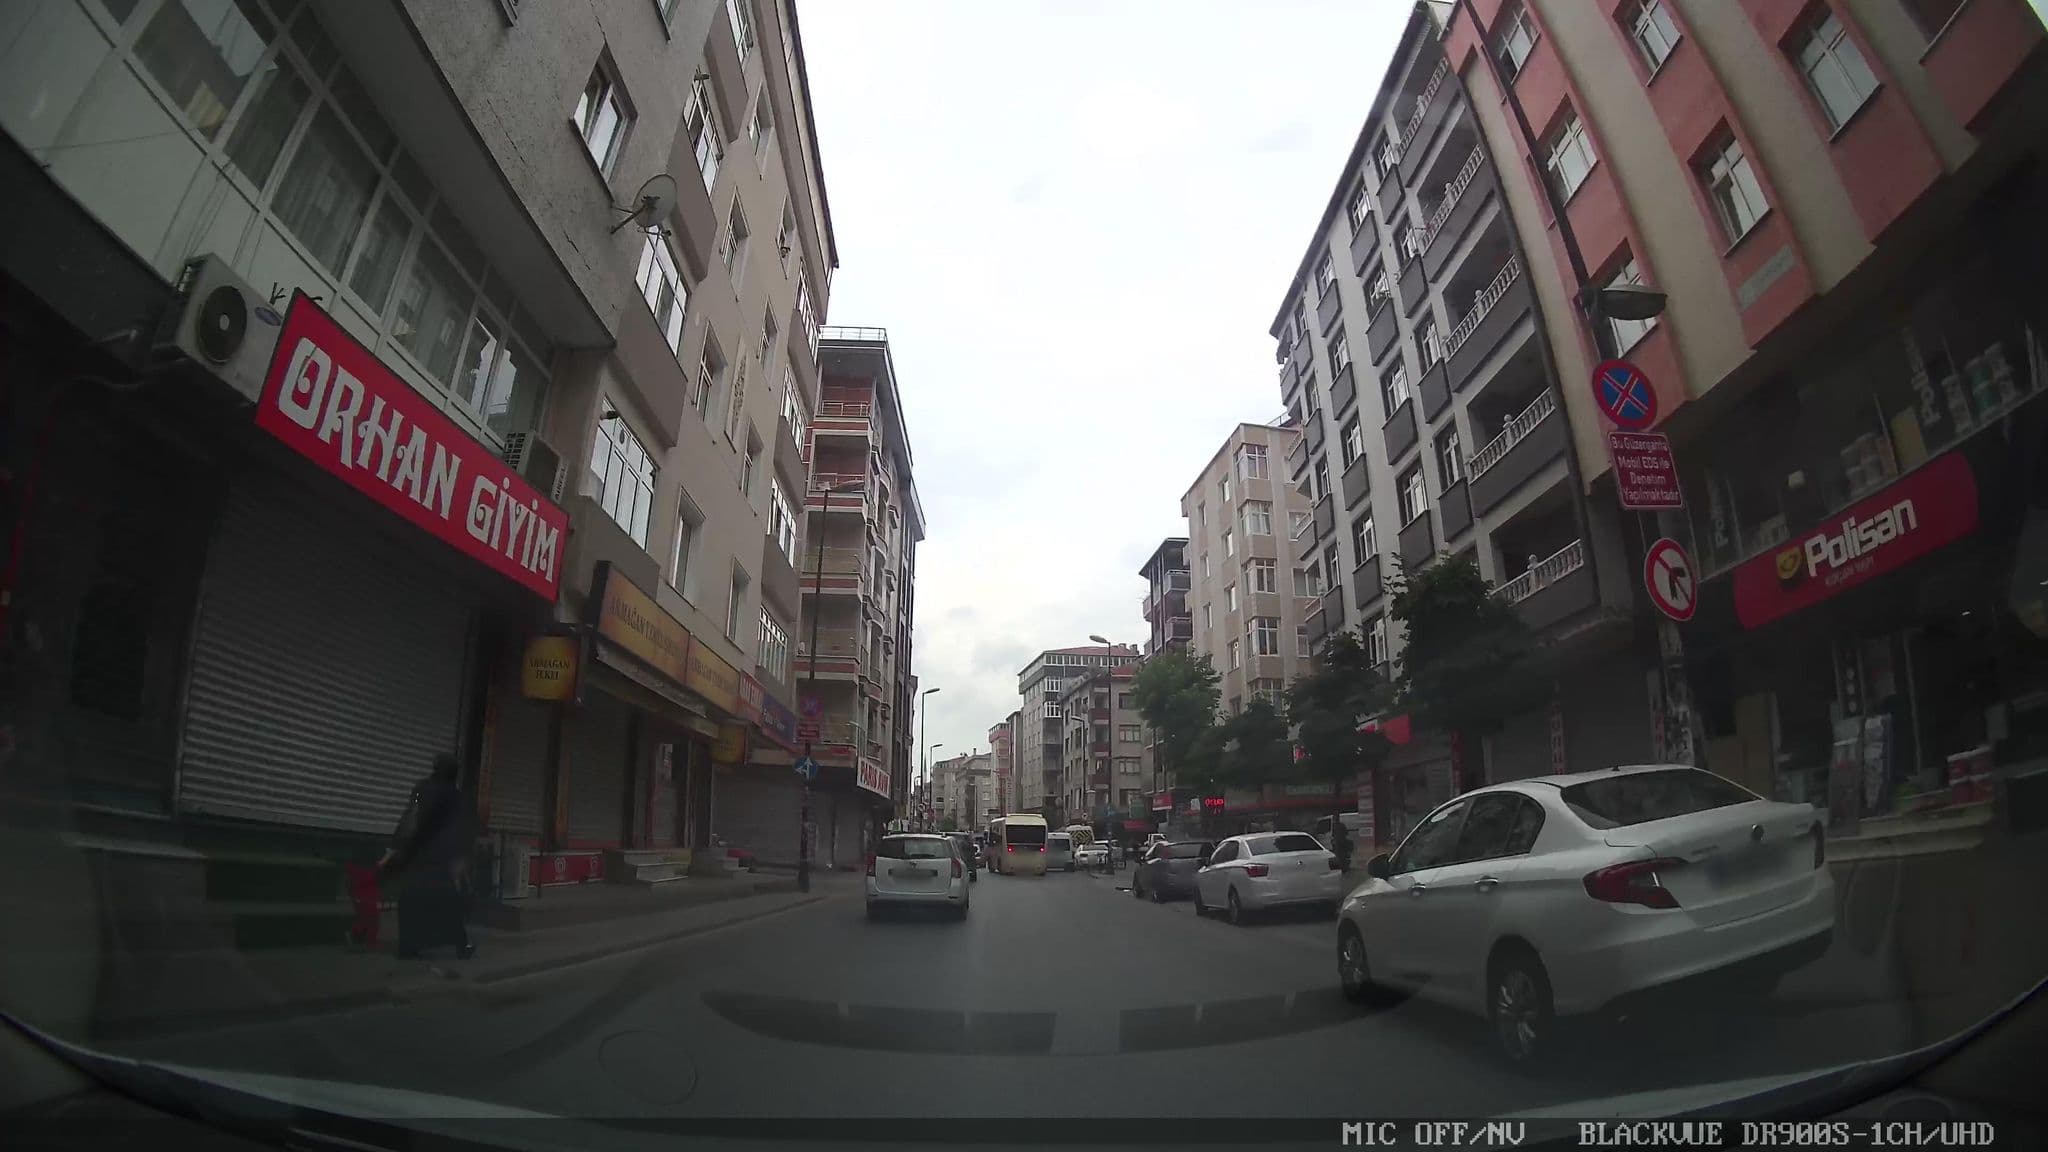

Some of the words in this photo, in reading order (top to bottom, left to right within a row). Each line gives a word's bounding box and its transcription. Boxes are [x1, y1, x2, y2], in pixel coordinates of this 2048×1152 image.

[278, 337, 462, 521] ORHAN
[466, 477, 559, 583] GİYİM
[1610, 436, 1623, 448] Bu
[1617, 455, 1641, 468] Mobil
[1804, 498, 1918, 577] Polisan
